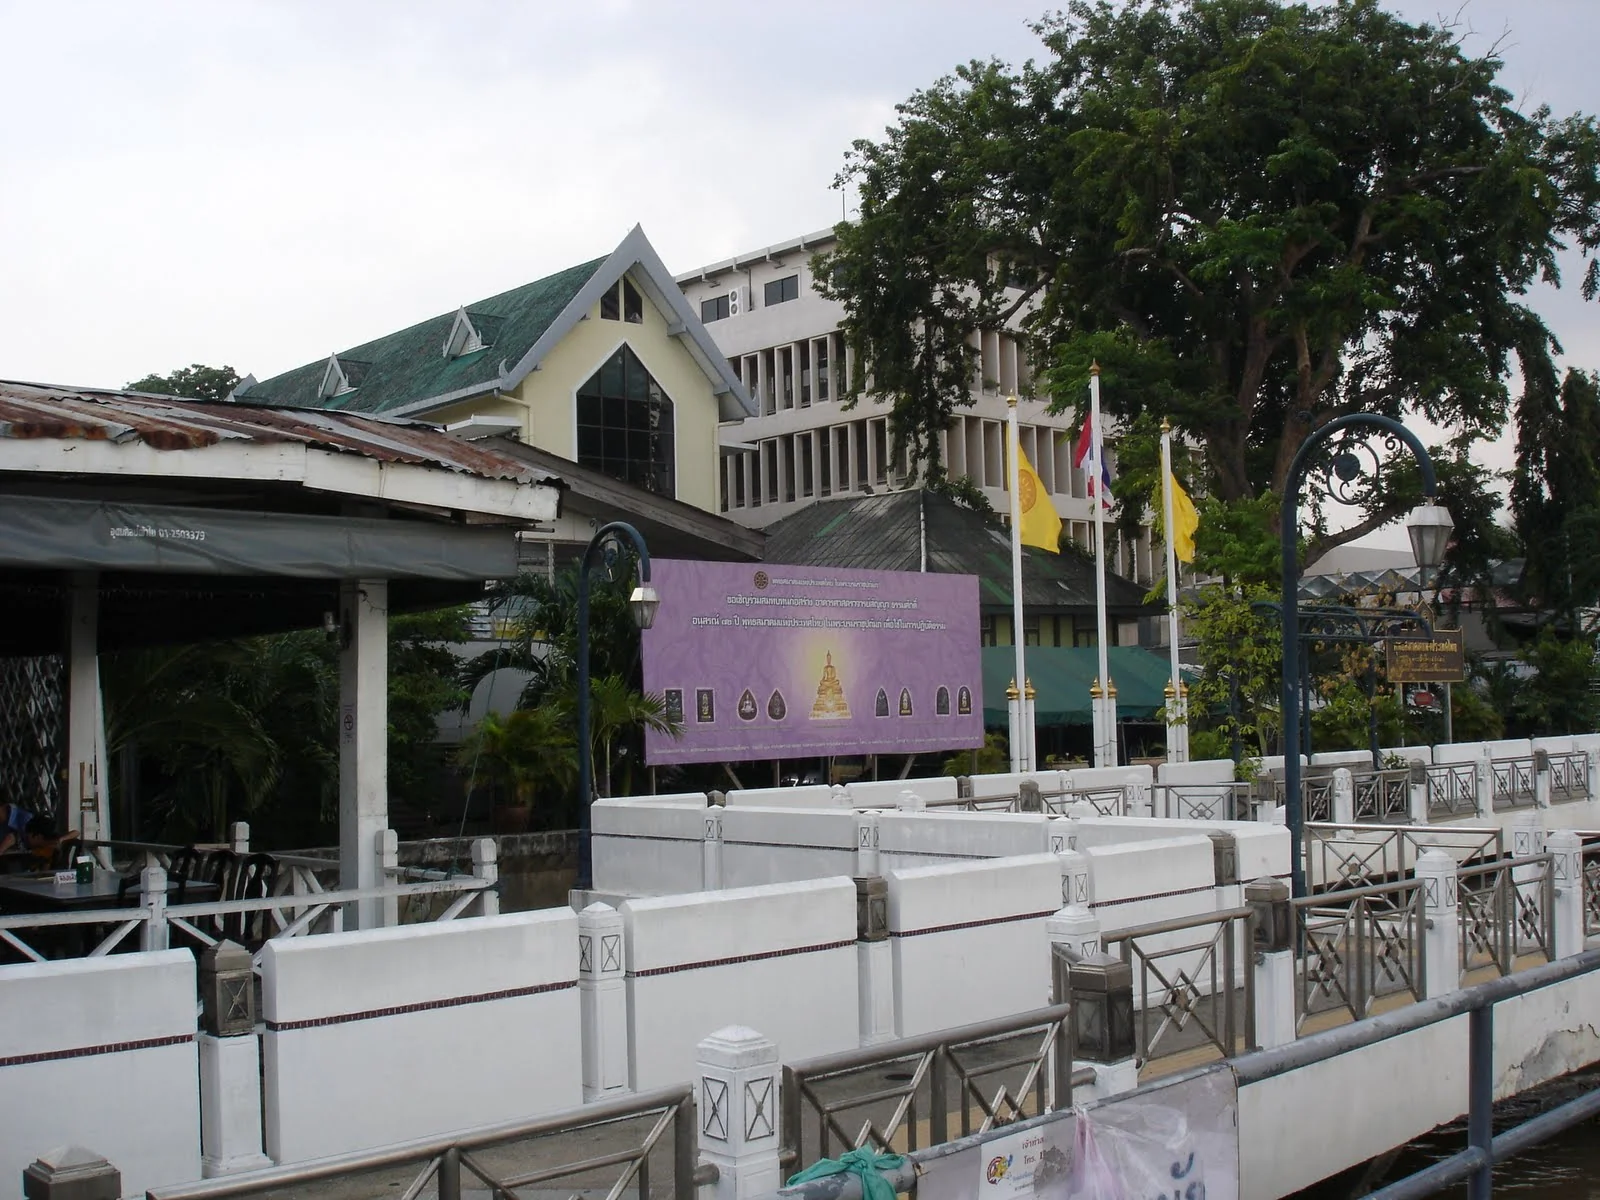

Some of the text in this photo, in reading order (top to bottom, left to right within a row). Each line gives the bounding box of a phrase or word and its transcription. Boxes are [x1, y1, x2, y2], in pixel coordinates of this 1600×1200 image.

[692, 613, 720, 628] อนุสรณ์
[733, 614, 740, 626] ปี
